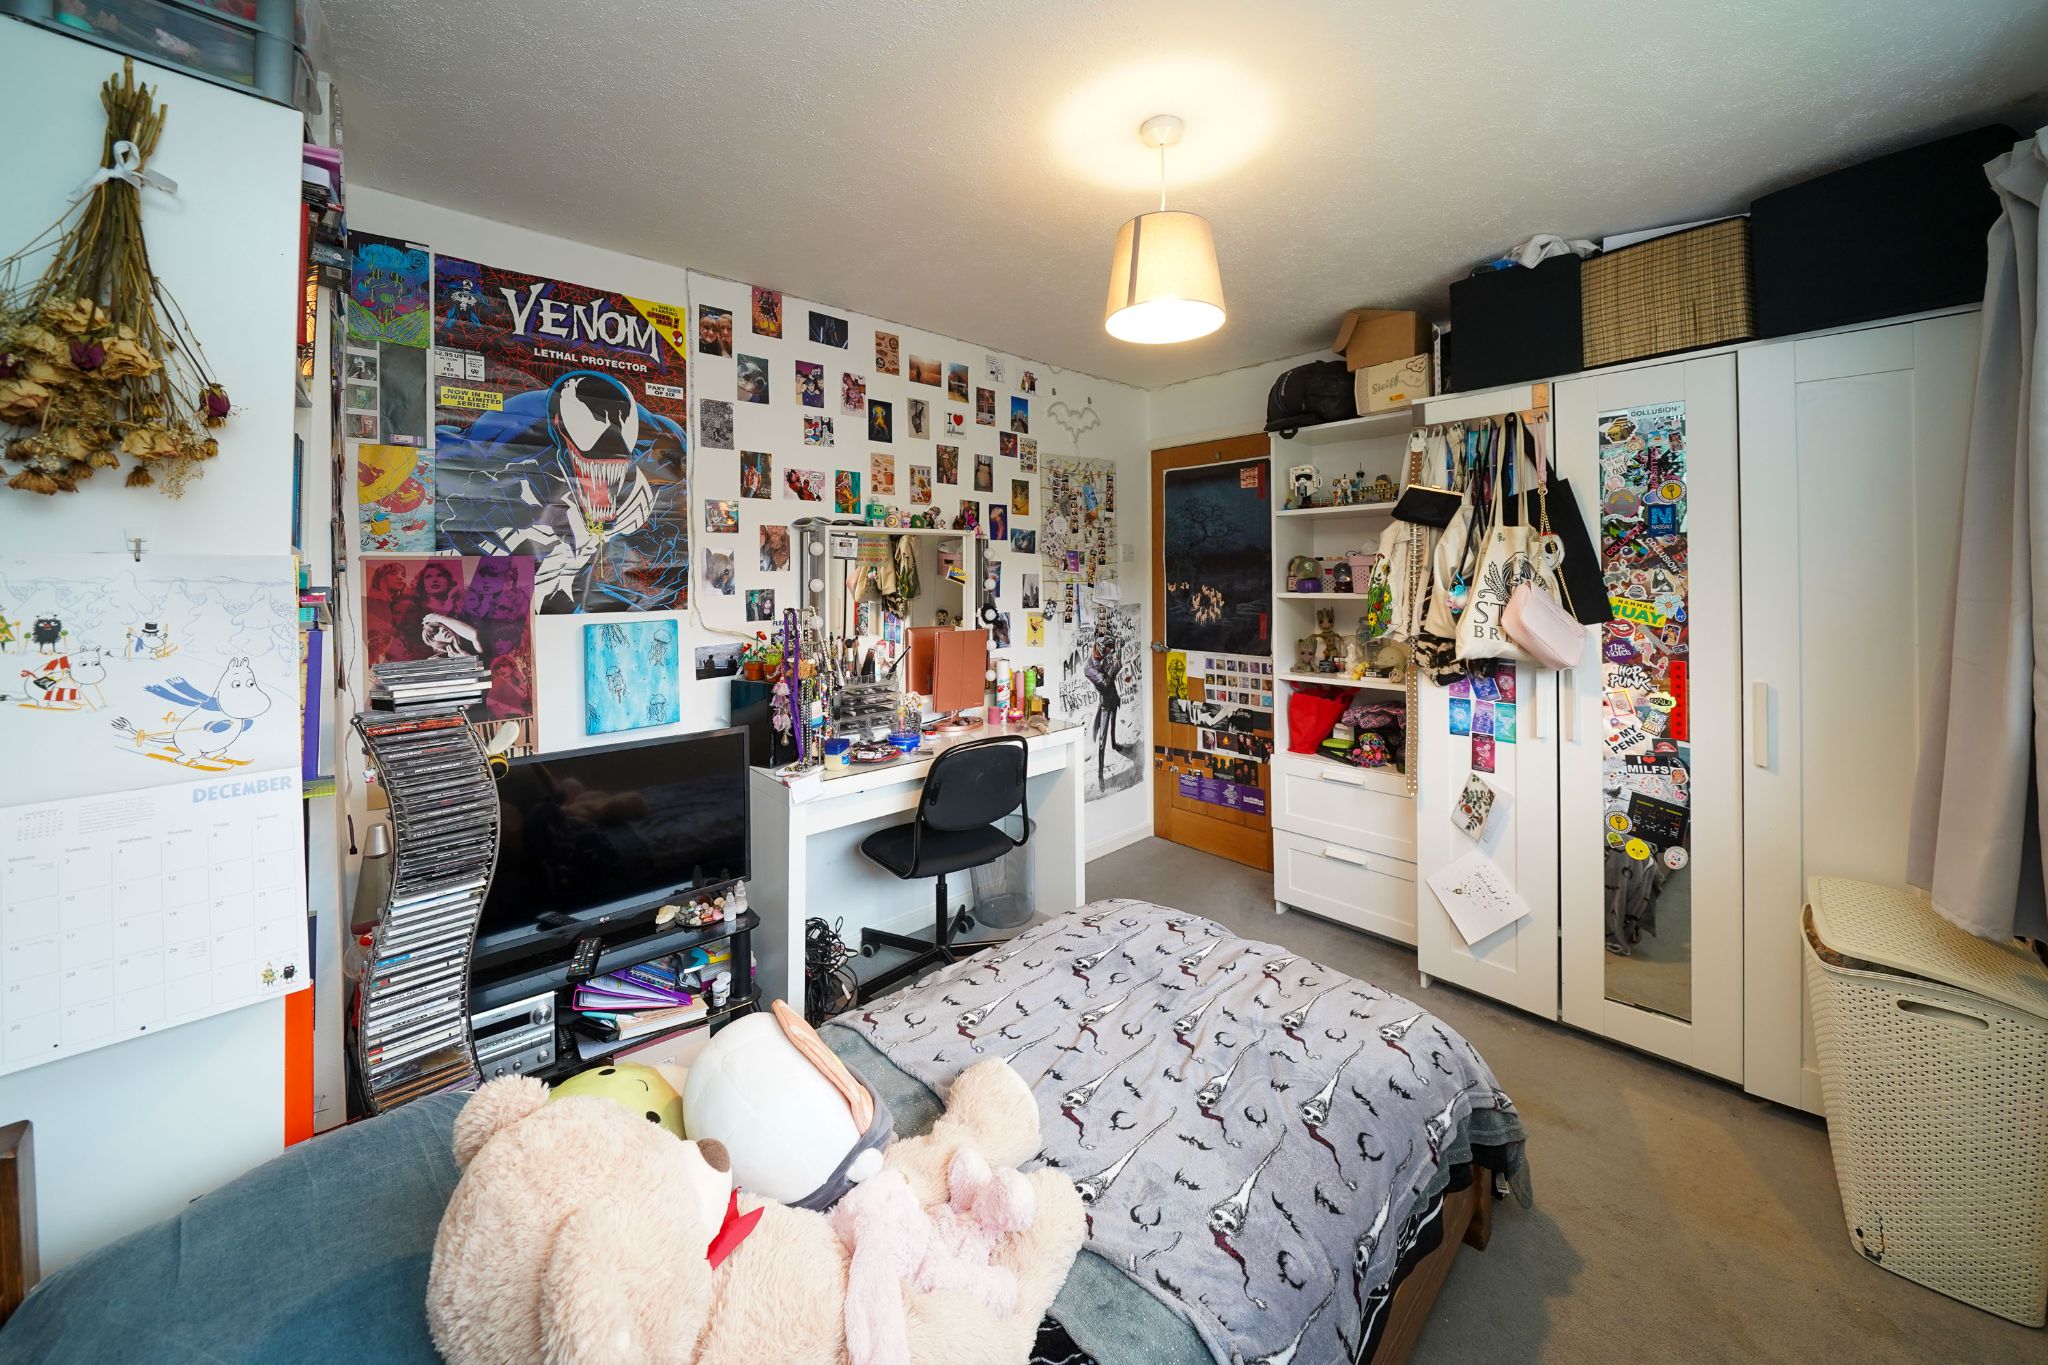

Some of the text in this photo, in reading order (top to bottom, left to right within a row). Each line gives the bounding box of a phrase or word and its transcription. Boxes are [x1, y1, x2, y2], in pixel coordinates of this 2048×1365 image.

[500, 282, 661, 364] VENOM
[534, 347, 648, 373] LETHAL PROTECTOR
[1371, 375, 1400, 395] Steiff
[467, 397, 502, 405] LIMITED
[947, 412, 953, 425] I
[1630, 405, 1678, 418] COLLUSION
[1645, 537, 1680, 573] COLLUSION
[1617, 599, 1655, 611] NAMMAN
[1618, 664, 1642, 679] HOP
[1608, 672, 1653, 692] PUNK
[1619, 724, 1637, 739] MY
[1611, 732, 1646, 754] PENIS
[1636, 755, 1642, 765] I
[1627, 764, 1670, 775] MILFS
[192, 775, 292, 803] DECEMBER
